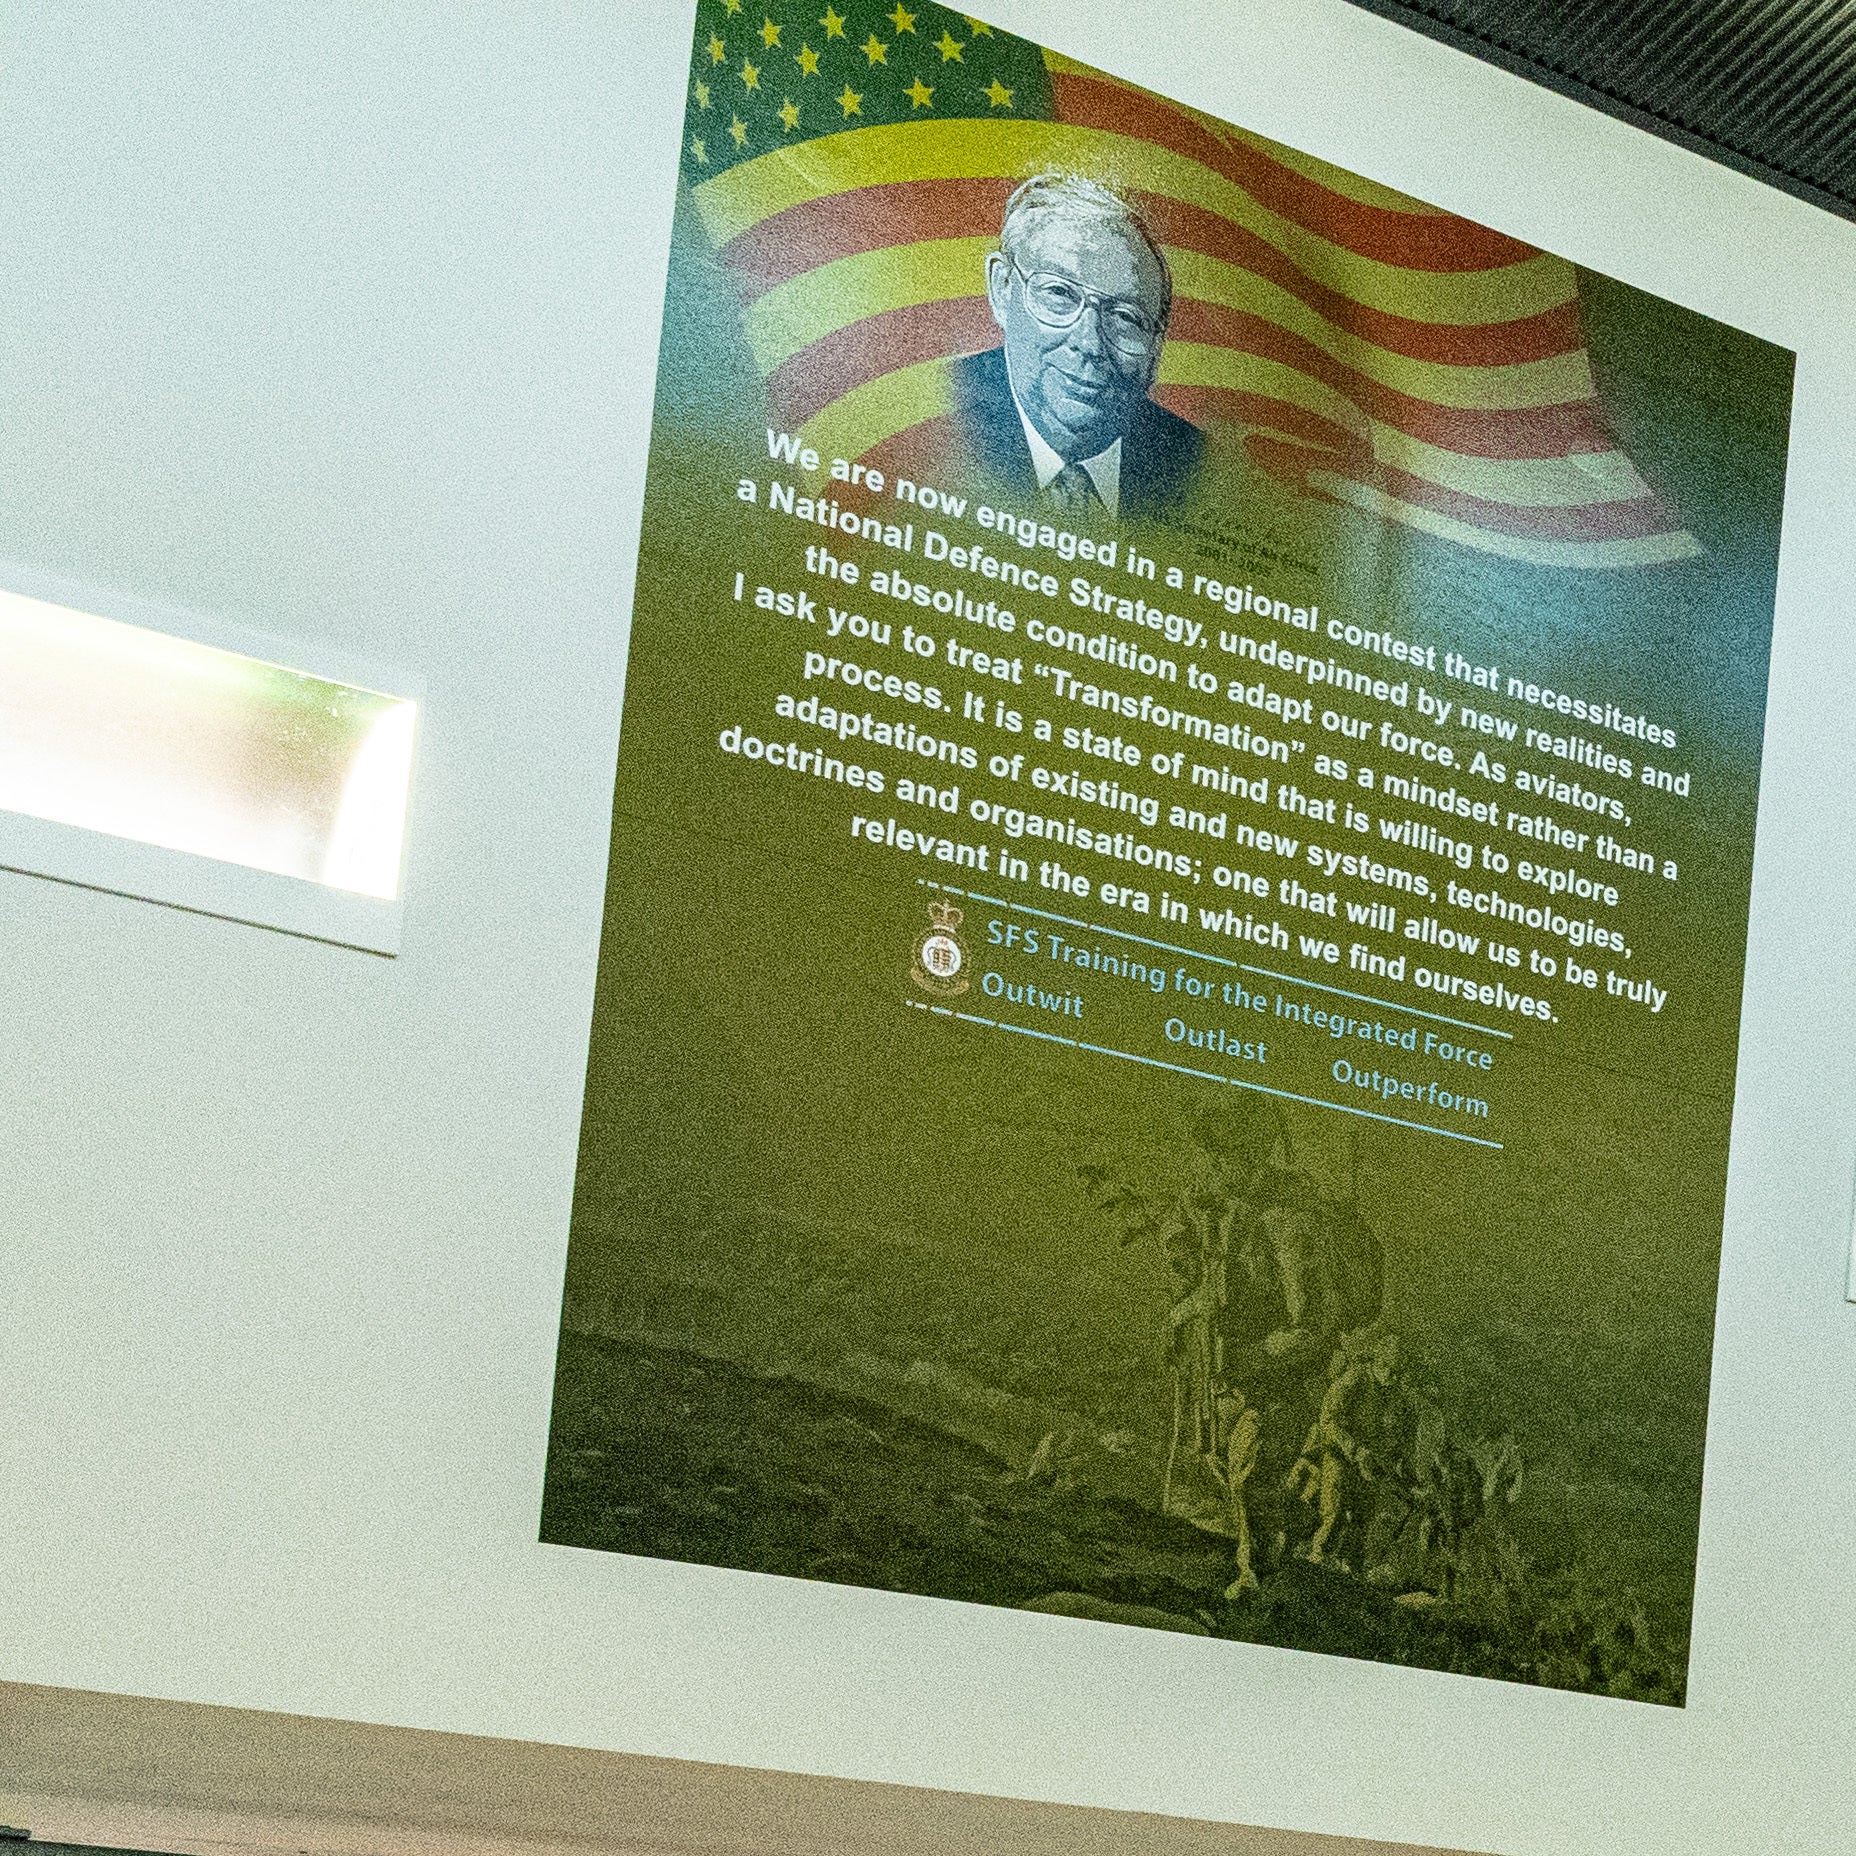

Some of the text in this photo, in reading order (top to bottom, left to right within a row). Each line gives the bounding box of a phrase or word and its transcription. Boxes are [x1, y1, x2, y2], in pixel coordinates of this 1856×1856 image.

[736, 478, 1691, 797] a National Defence Strategy, underpinned by new realities and
[764, 429, 1677, 749] We are now engaged in a regional contest that necessitates
[804, 545, 1632, 827] the absolute condition to adapt our force. As aviators,
[733, 572, 745, 601] I
[754, 586, 817, 623] ask
[826, 607, 892, 645] you
[902, 625, 936, 658] to
[946, 638, 1023, 685] treat
[1314, 754, 1348, 781] as
[1357, 767, 1374, 789] a
[1383, 774, 1499, 827] mindset
[1506, 811, 1590, 853] rather
[1595, 834, 1655, 874] than
[1662, 860, 1678, 881] a
[774, 694, 1632, 959] adaptations of existing and new systems, technologies,
[803, 651, 1619, 907] process. It is a state of mind that is willing to explore
[718, 725, 1668, 1013] doctrines and organisations; one that will allow us to be truly
[851, 816, 1559, 1024] relevant in the era in which we find ourselves.
[987, 919, 1493, 1070] SFS Training for the Integrated Force
[981, 972, 1489, 1118] Outwit Outlast Outperform
